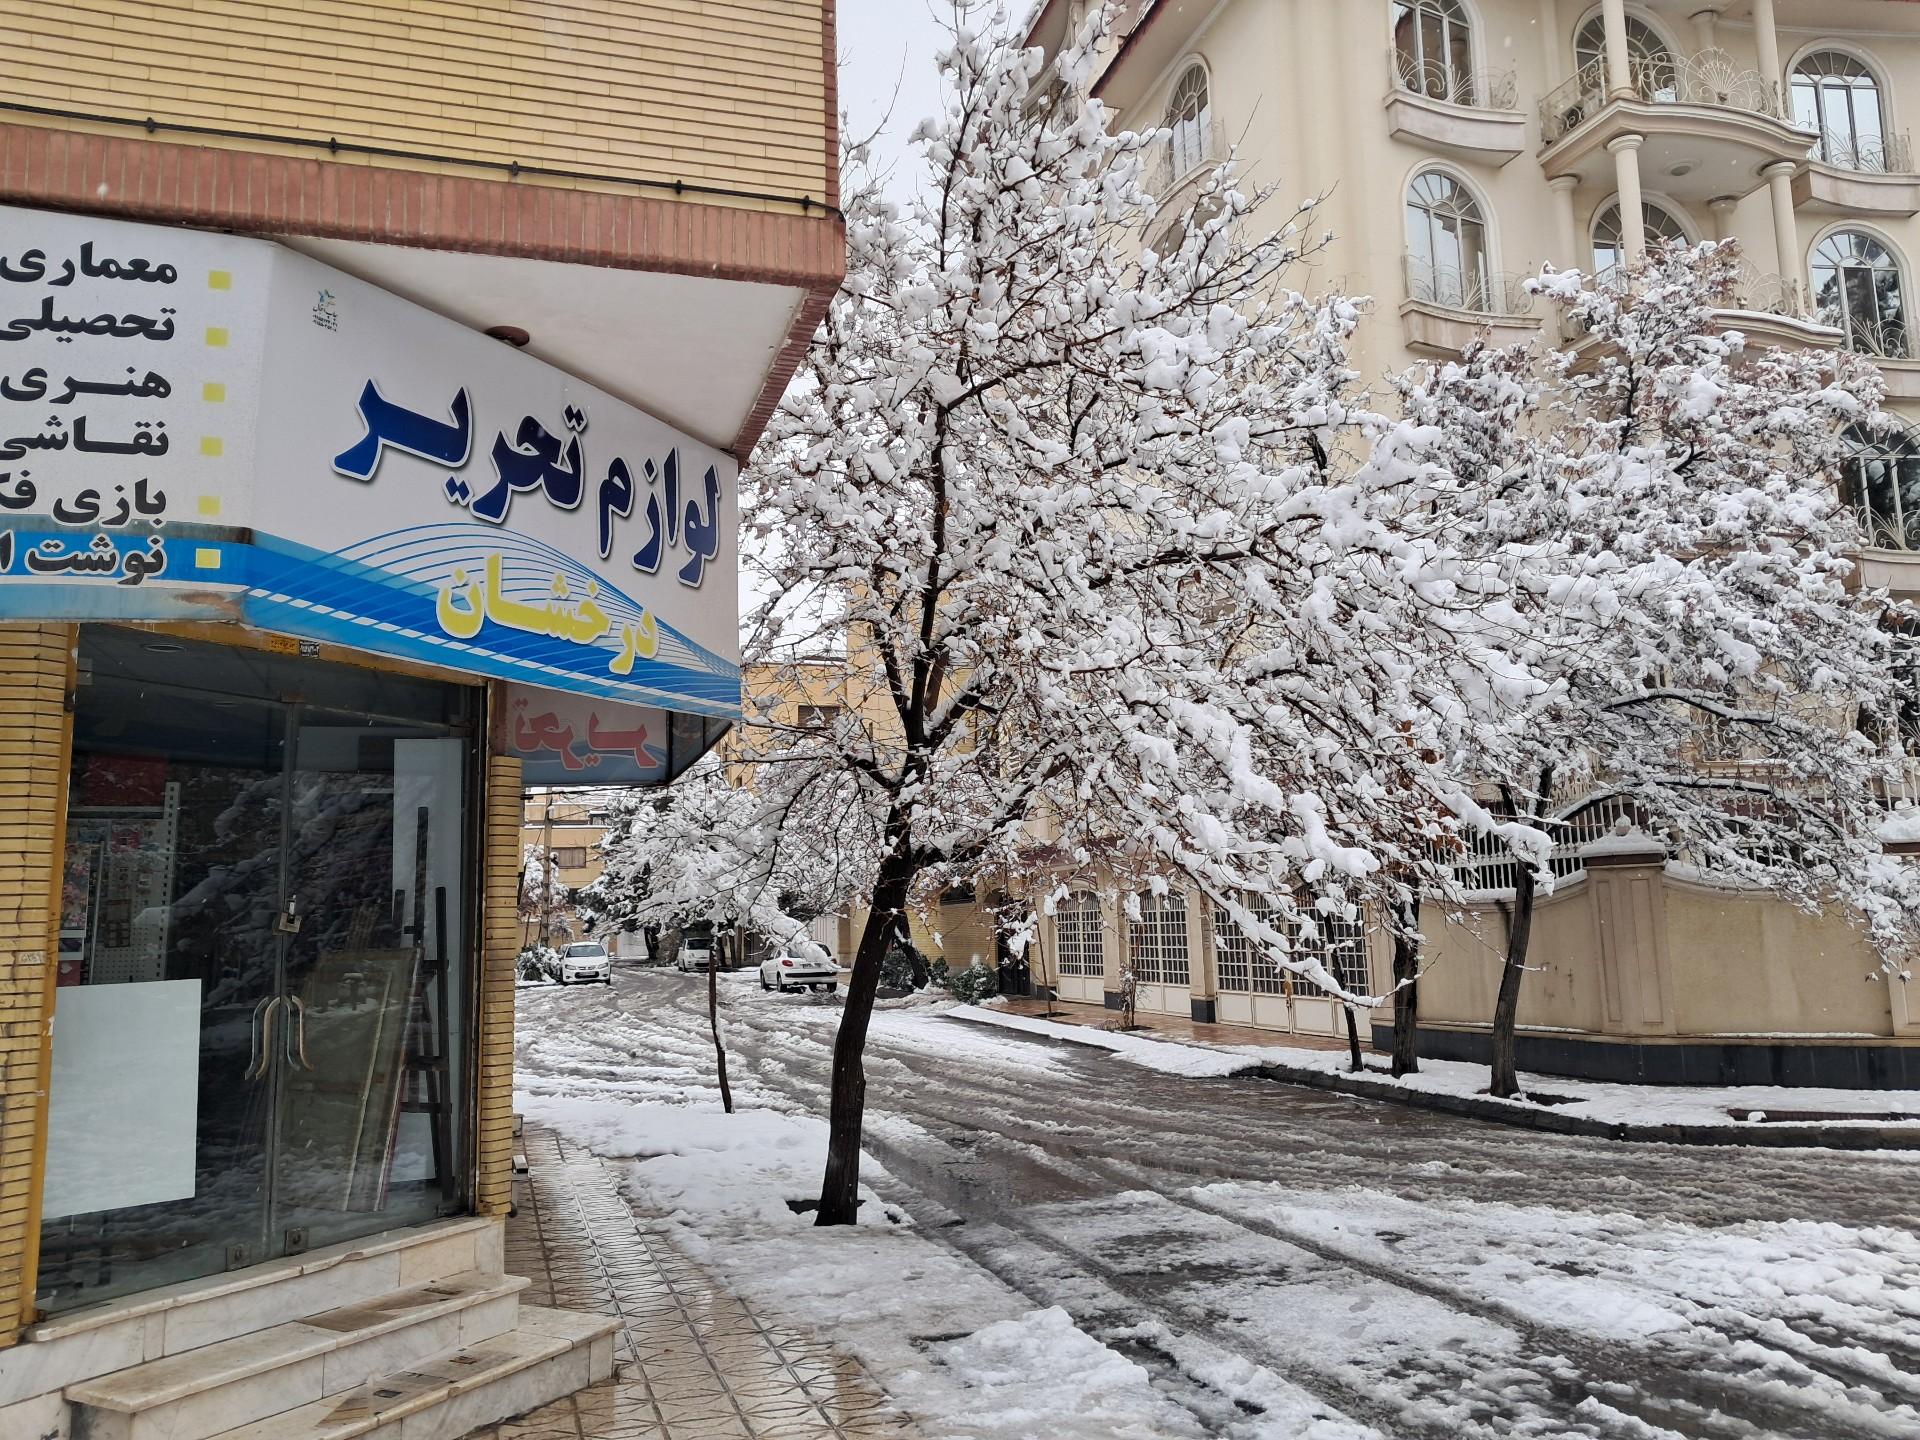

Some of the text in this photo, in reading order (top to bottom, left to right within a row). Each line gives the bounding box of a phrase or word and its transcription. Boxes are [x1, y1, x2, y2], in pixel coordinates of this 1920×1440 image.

[0, 240, 179, 286] معماری
[0, 295, 177, 343] تحصیلی
[0, 366, 172, 404] هنری
[0, 414, 170, 461] نقاشی
[52, 477, 167, 528] بازی
[331, 377, 720, 588] لوازم تحریر
[25, 533, 167, 586] نوشت
[436, 552, 659, 675] درخشان
